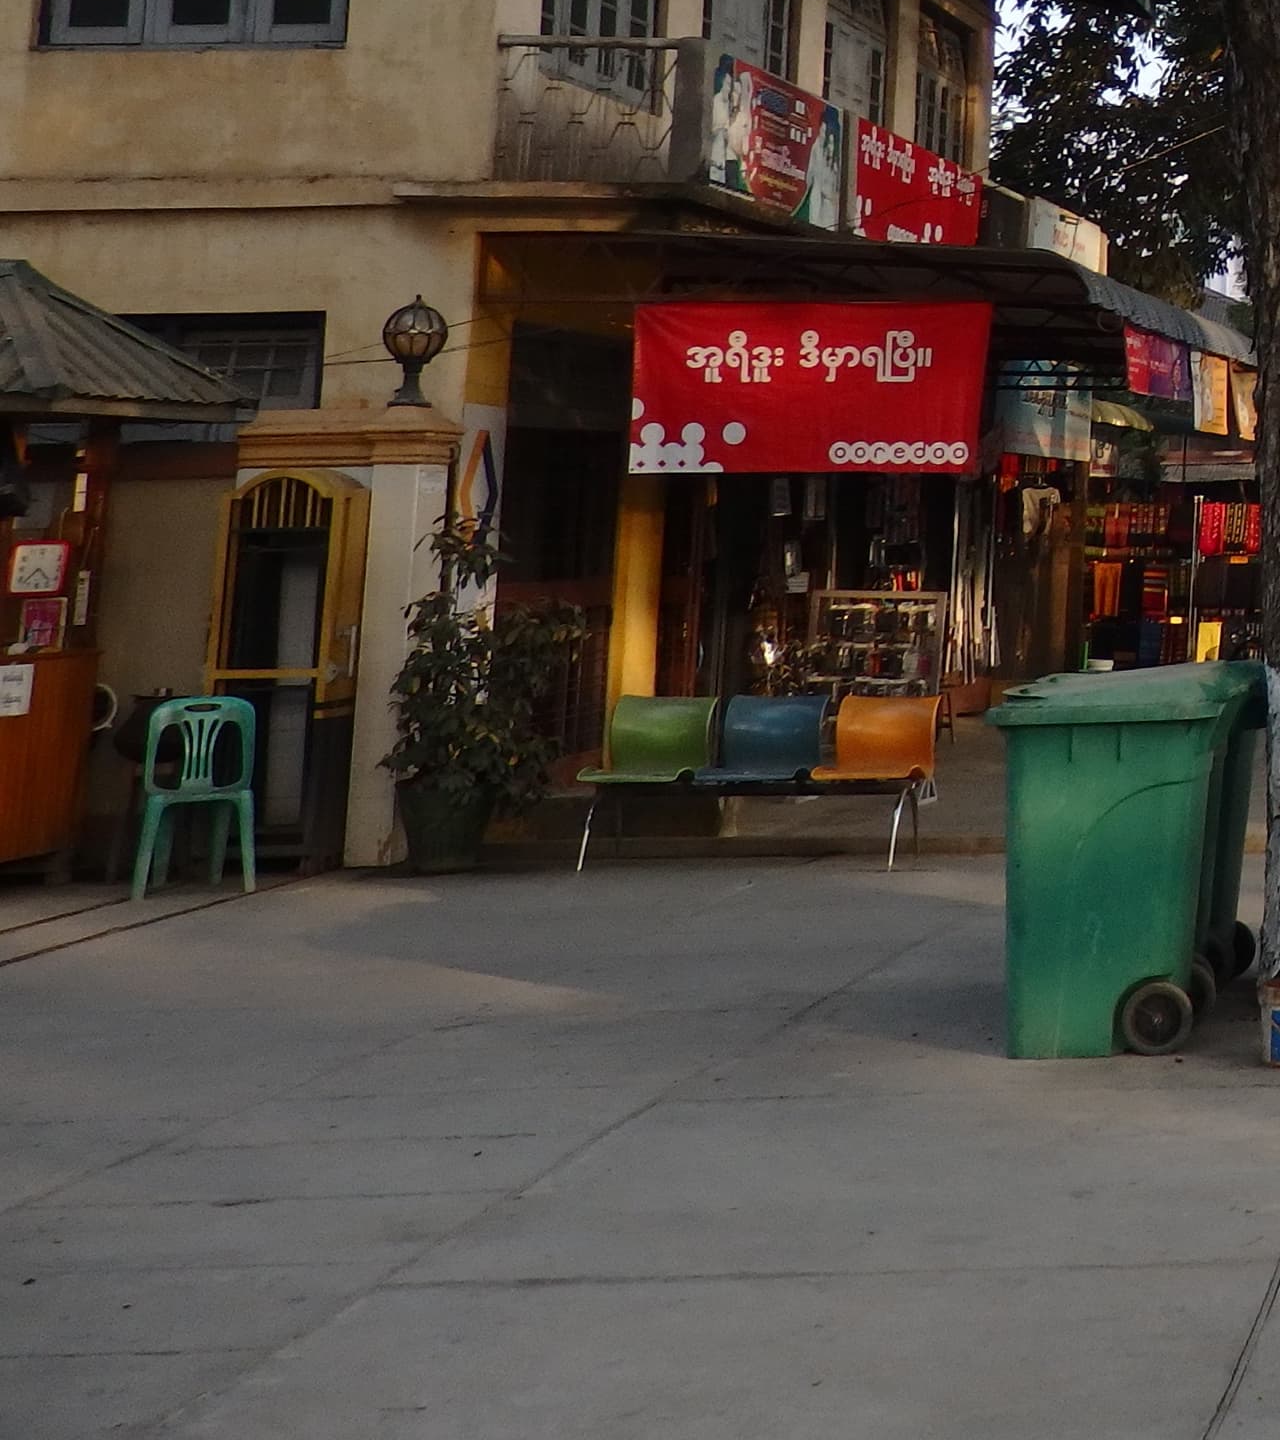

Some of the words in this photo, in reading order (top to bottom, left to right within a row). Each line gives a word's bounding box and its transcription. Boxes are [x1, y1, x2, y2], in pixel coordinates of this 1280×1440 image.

[686, 330, 784, 383] အူရီဒူး
[829, 441, 969, 465] ooredoo
